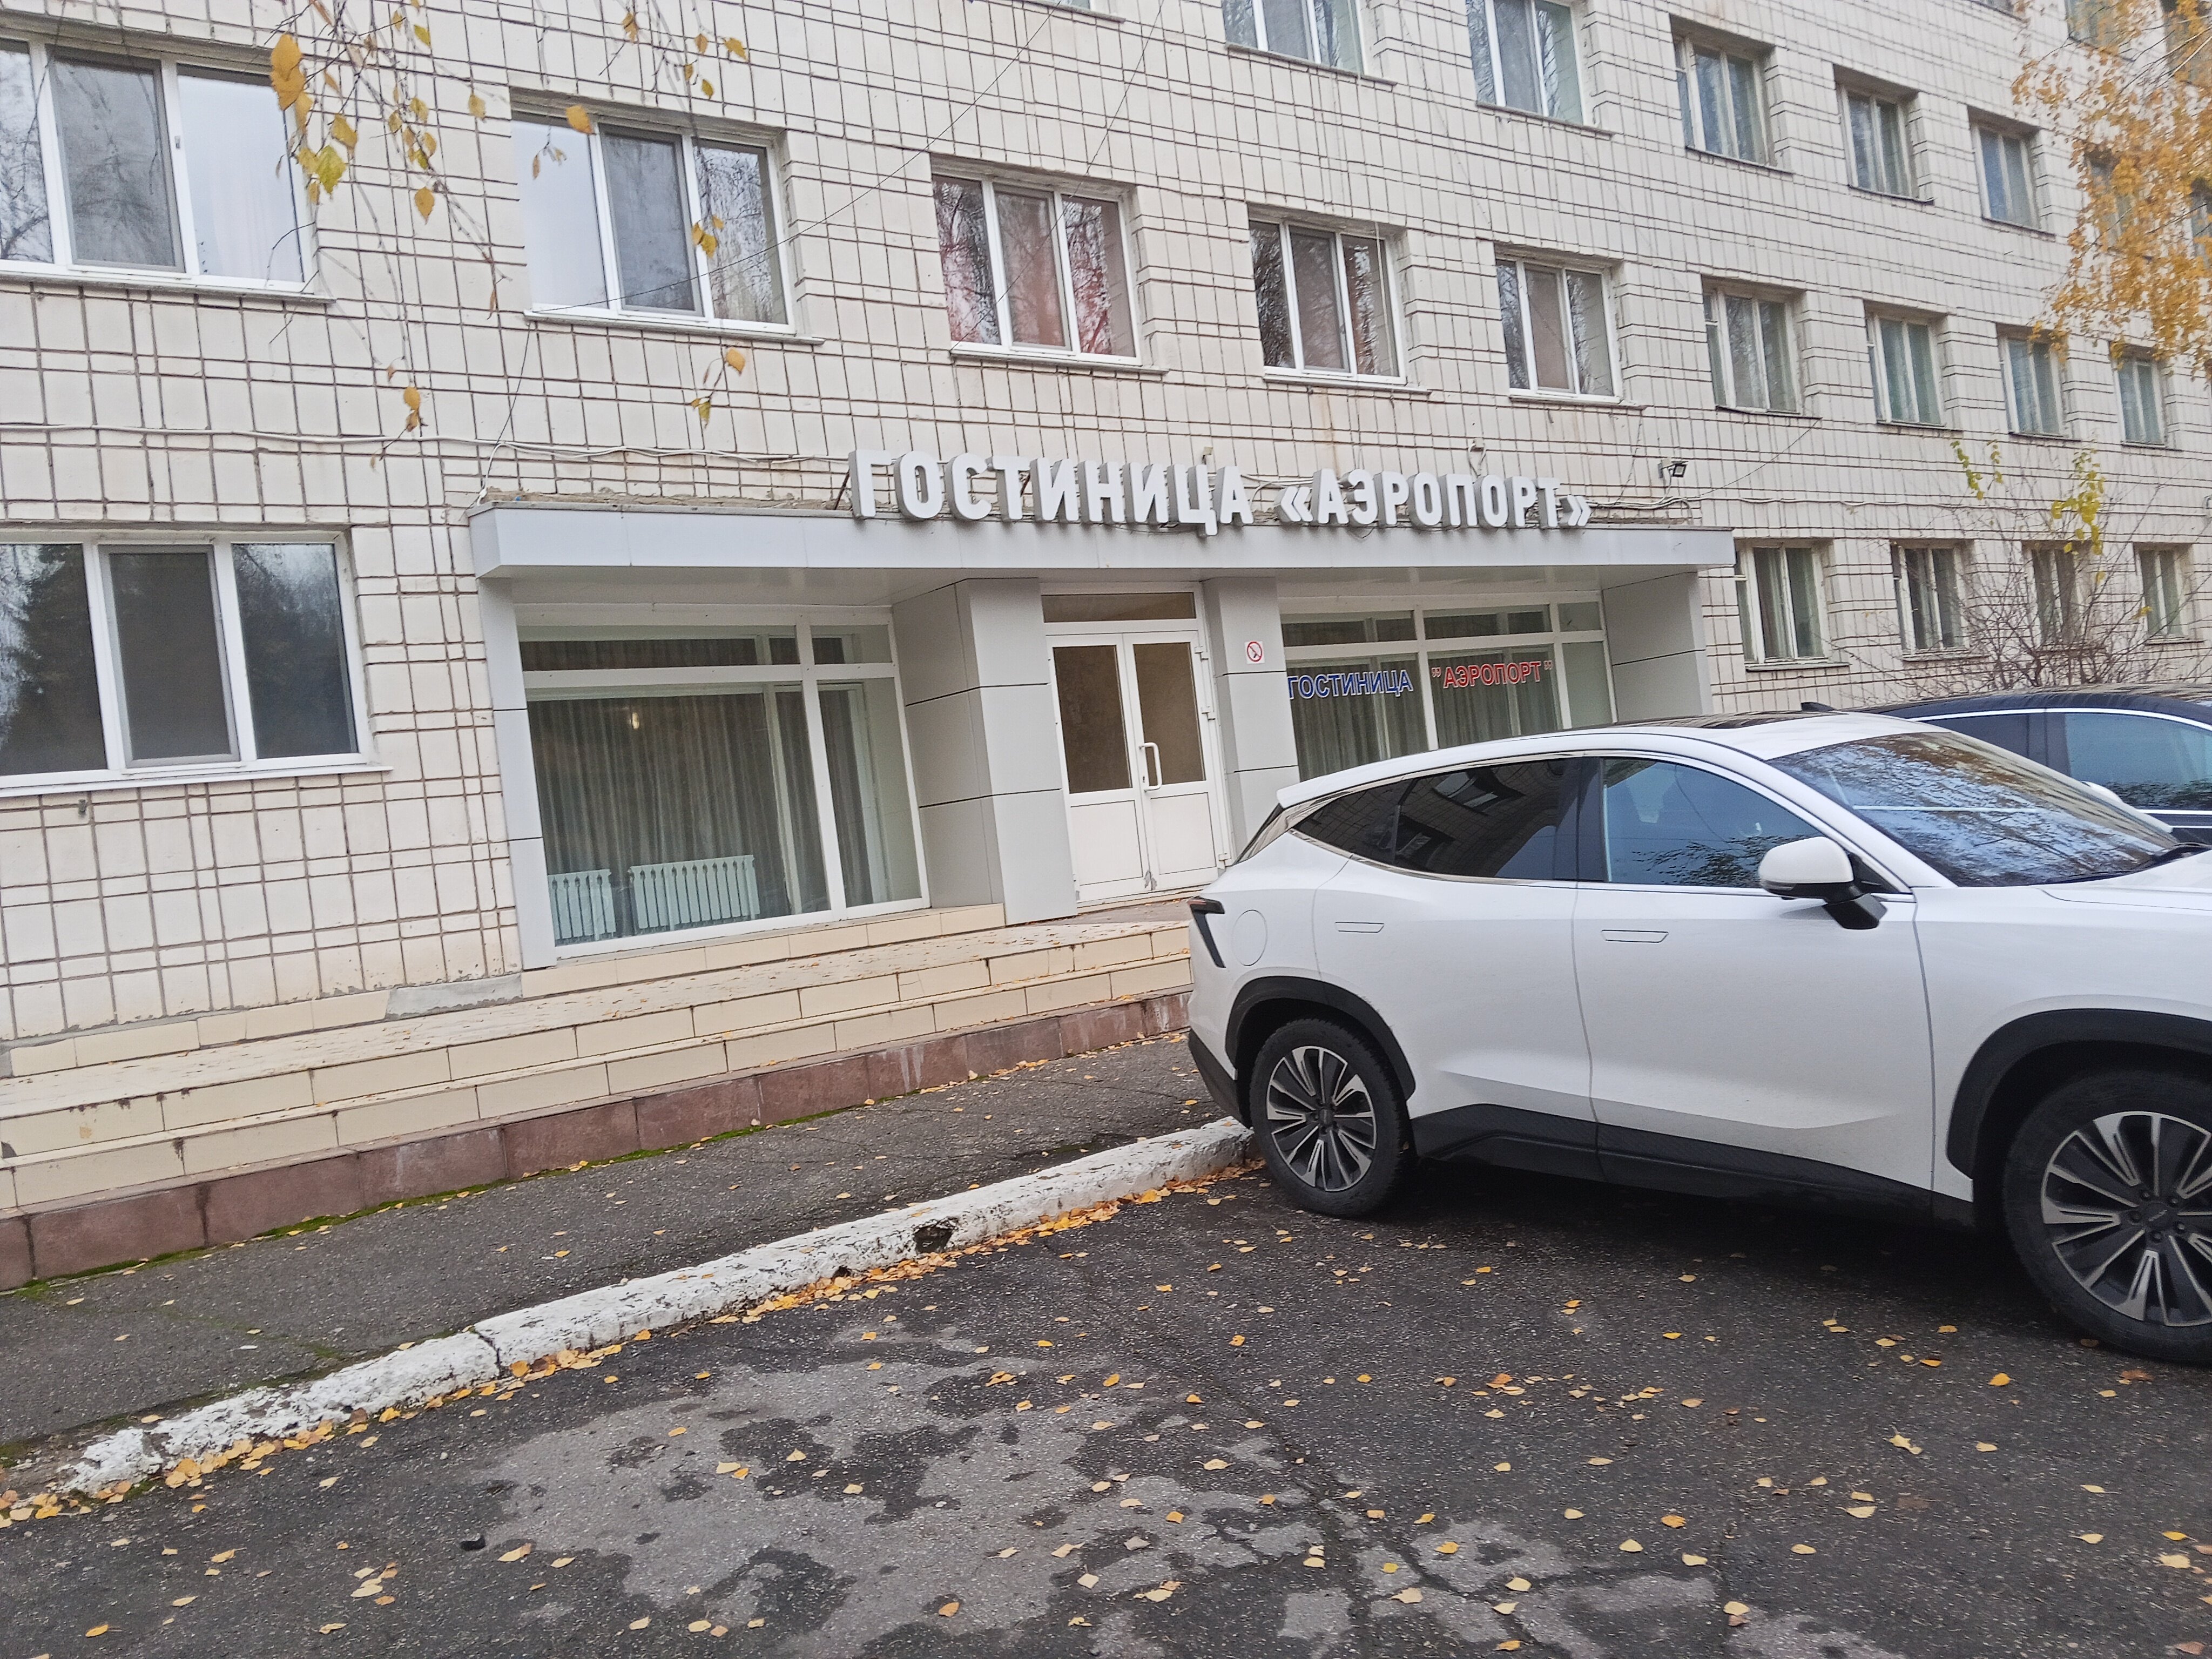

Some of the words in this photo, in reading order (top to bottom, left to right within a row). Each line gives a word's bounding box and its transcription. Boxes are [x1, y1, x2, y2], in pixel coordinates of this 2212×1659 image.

[849, 450, 1254, 536] ГОСТИНИЦА
[1274, 468, 1592, 528] «АЭРОПОРТ»
[1287, 670, 1414, 699] ГОСТИНИЦА
